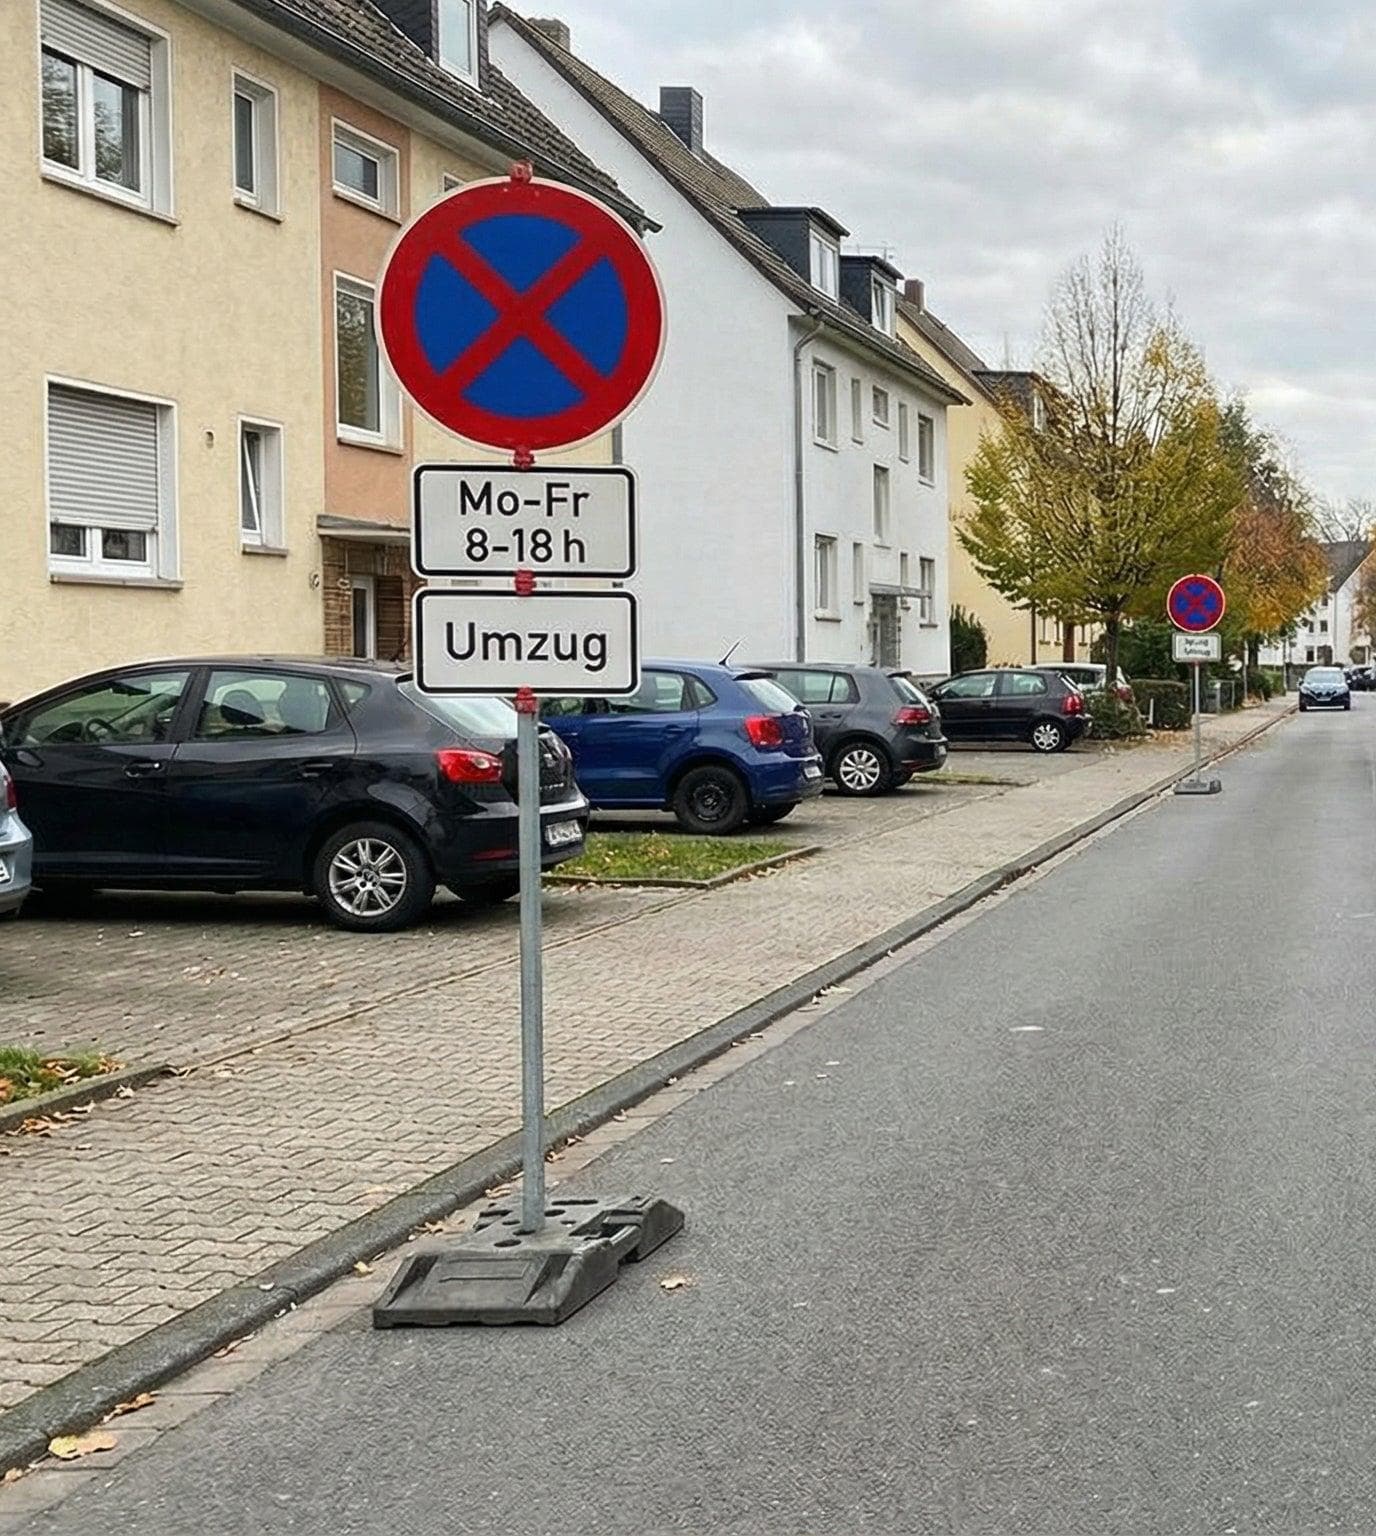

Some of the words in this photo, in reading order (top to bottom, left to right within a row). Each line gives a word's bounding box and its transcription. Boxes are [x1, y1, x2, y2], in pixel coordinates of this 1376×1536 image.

[459, 480, 590, 518] Mo-Fr
[563, 529, 585, 564] h
[446, 621, 607, 672] Umzug
